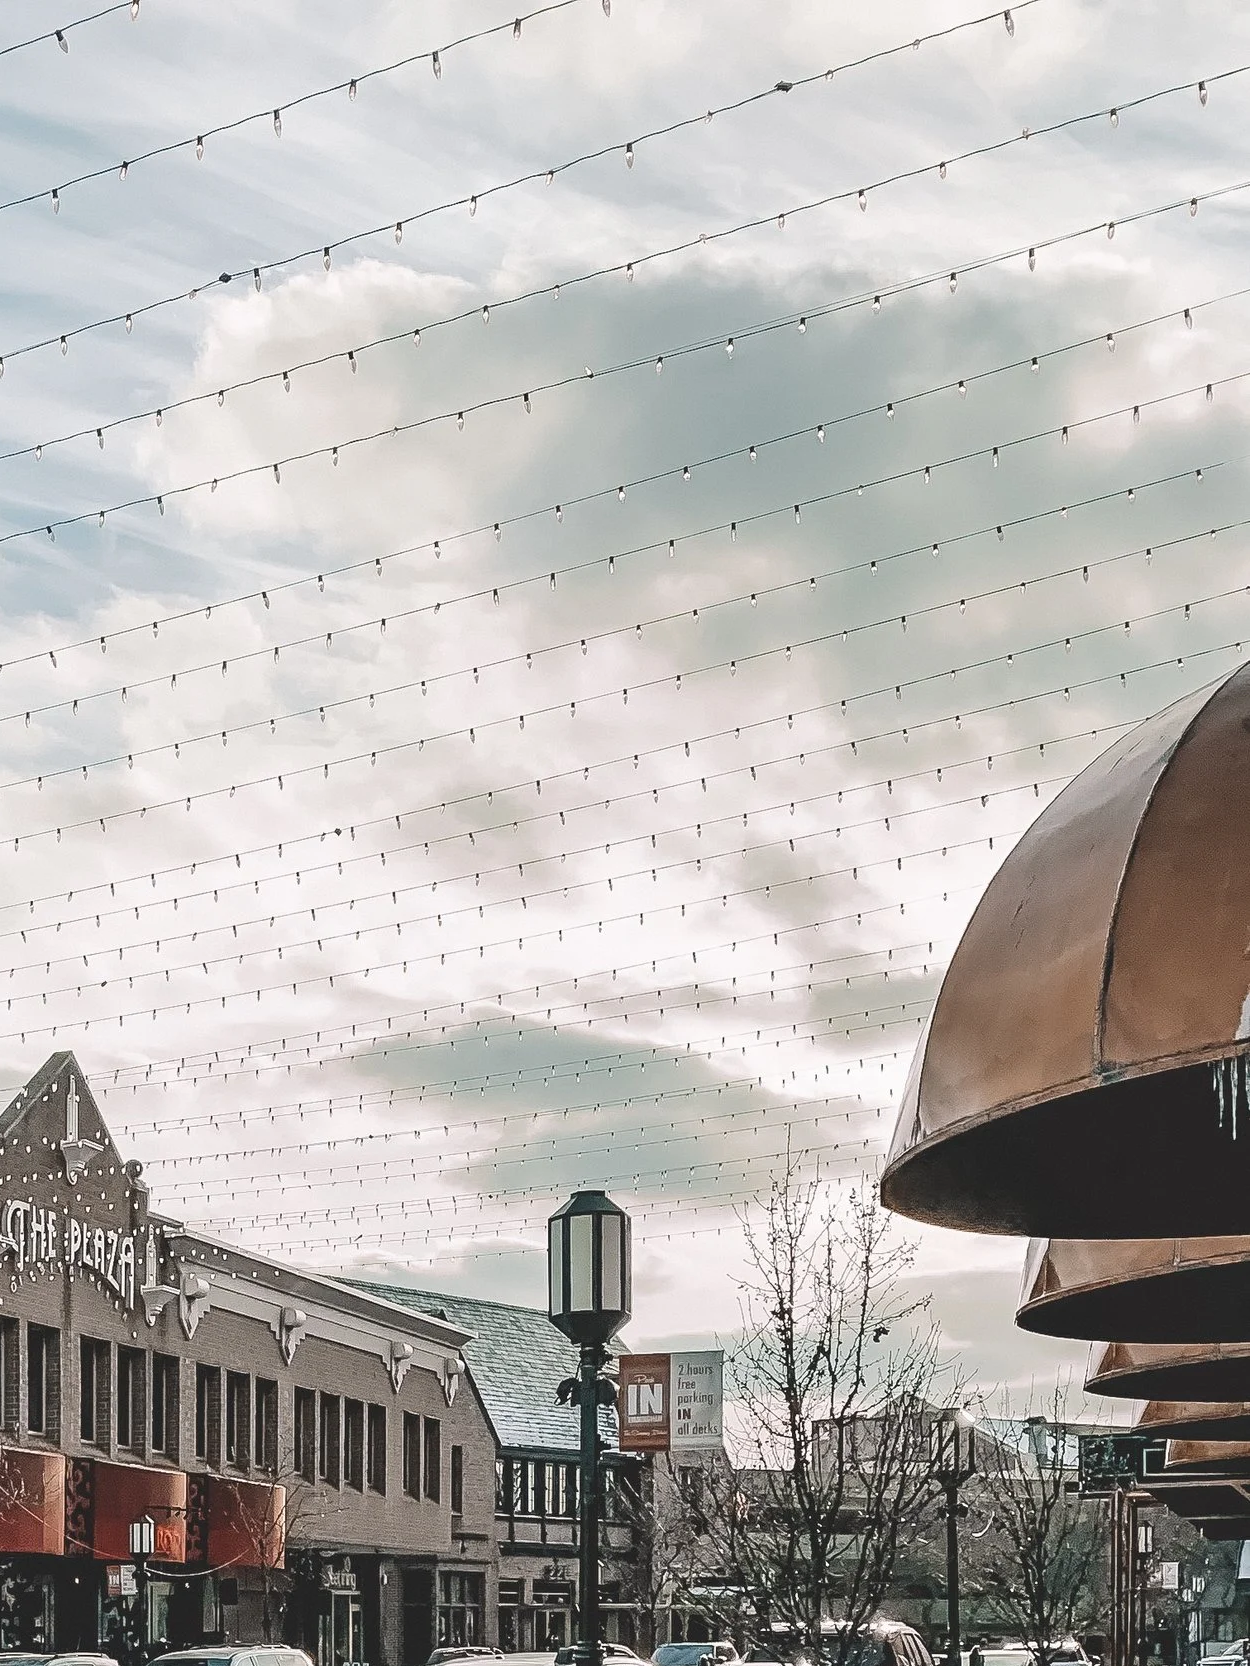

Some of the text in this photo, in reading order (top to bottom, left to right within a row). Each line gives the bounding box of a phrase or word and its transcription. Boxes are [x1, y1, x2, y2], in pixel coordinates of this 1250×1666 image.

[7, 1200, 57, 1272] THE
[70, 1217, 135, 1310] PLAZA
[678, 1363, 713, 1376] 2 hours
[677, 1378, 696, 1390] free
[628, 1384, 662, 1415] IN
[677, 1391, 714, 1407] parking
[677, 1408, 692, 1420] IN
[677, 1422, 690, 1435] all
[692, 1421, 718, 1435] decks
